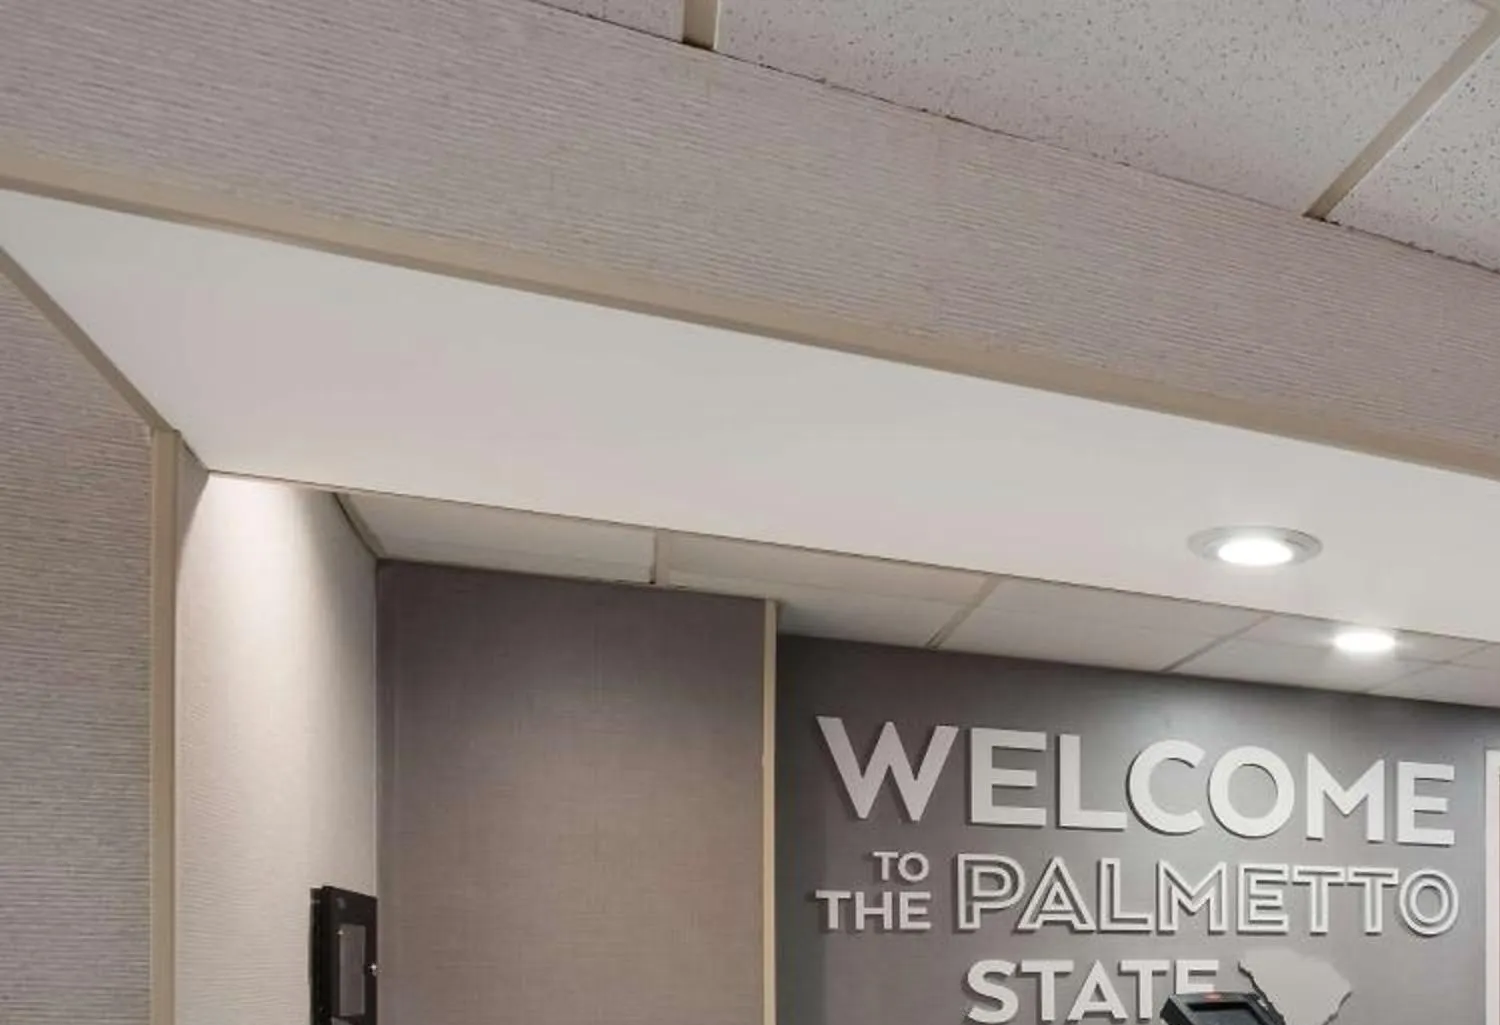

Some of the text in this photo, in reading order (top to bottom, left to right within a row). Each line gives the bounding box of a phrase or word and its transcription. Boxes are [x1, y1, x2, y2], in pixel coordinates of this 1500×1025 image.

[816, 715, 1455, 846] WELCOME
[815, 852, 1460, 938] THE PALMETTO
[872, 850, 930, 882] TO
